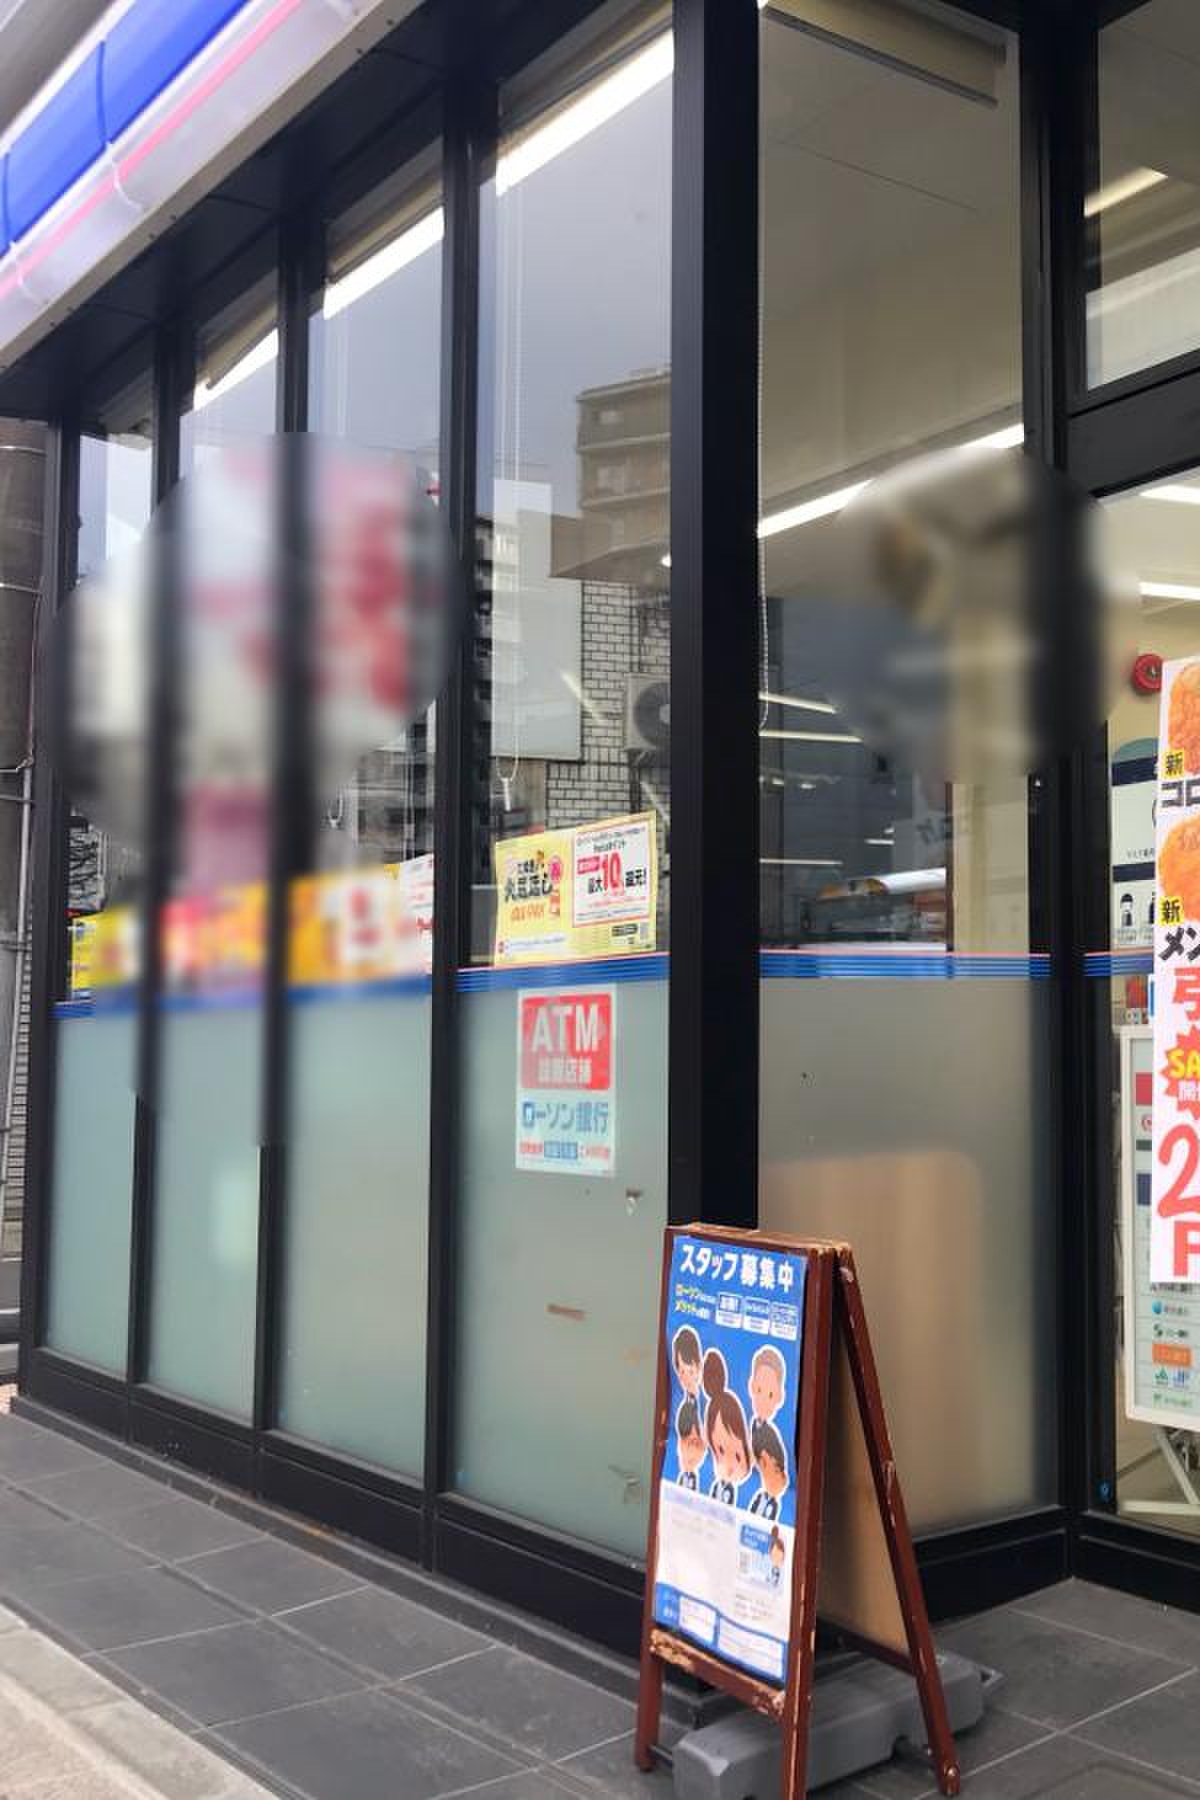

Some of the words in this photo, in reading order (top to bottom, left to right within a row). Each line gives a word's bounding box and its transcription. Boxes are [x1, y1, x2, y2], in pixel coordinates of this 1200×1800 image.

[1165, 752, 1184, 775] 新
[1161, 900, 1181, 923] 新
[532, 1004, 600, 1053] ATM
[522, 1101, 609, 1134] ローソン銀行
[680, 1244, 794, 1292] スタッフ募集中
